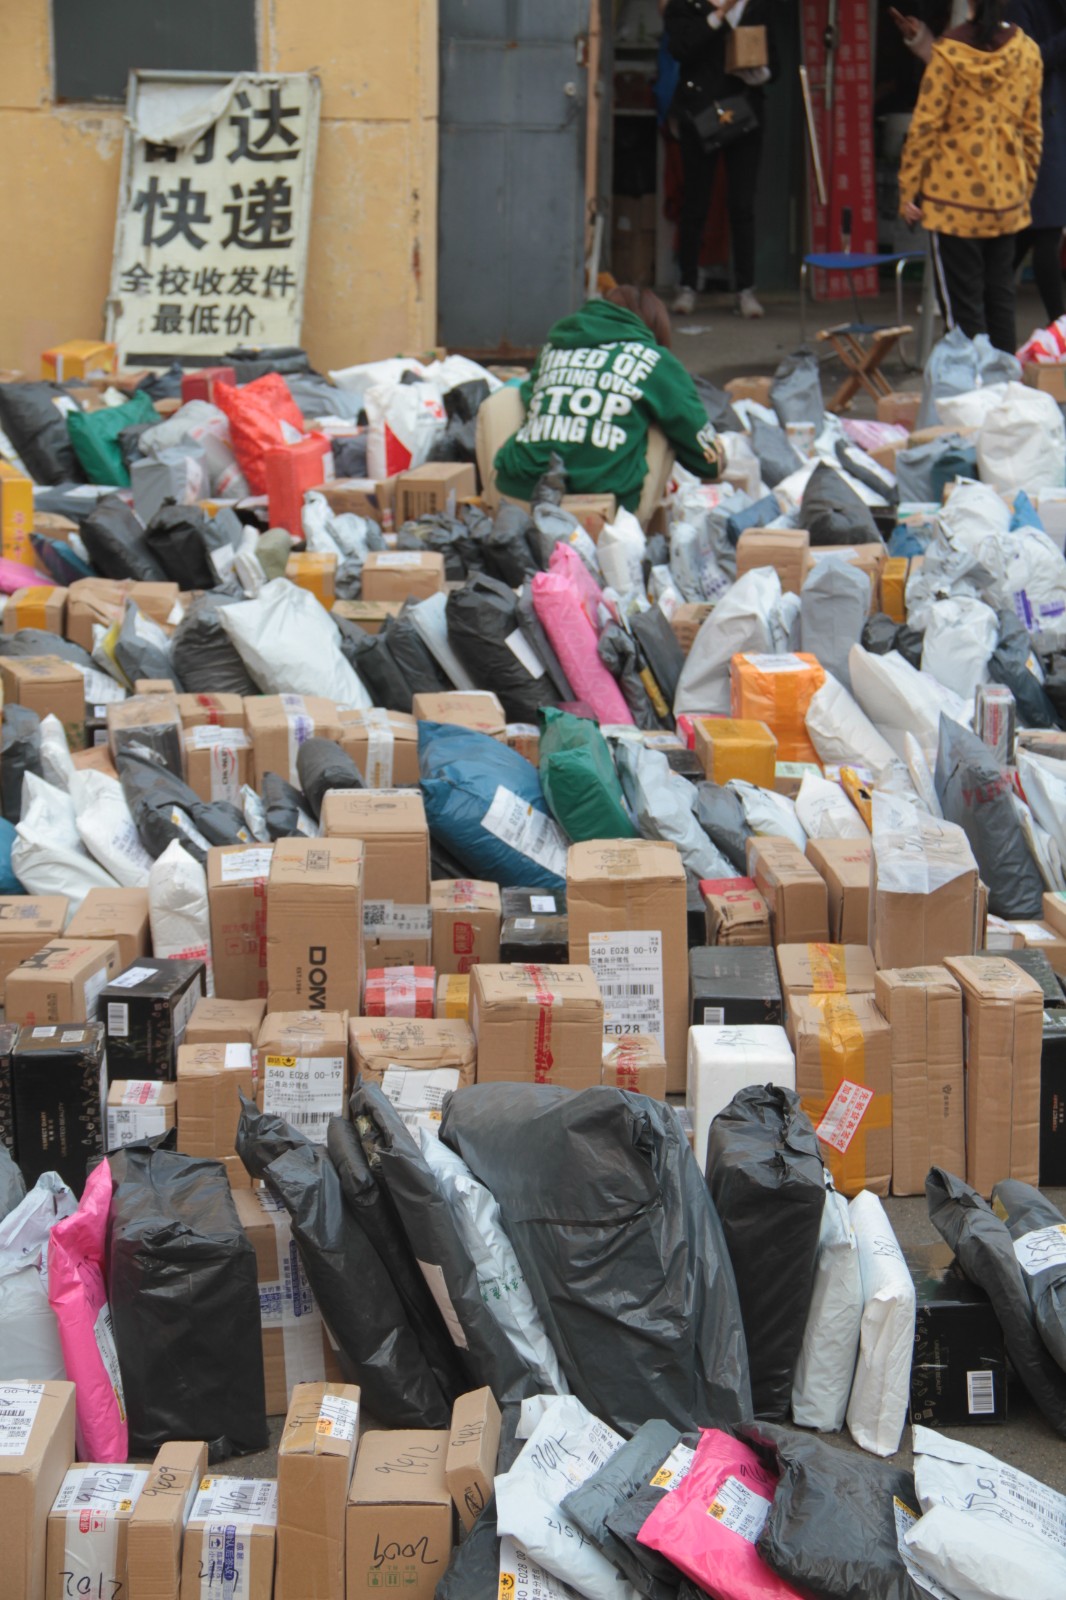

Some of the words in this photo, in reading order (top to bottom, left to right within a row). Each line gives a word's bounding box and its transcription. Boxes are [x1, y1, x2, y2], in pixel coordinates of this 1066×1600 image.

[133, 175, 293, 250] 快递
[121, 262, 297, 297] 全校收发件
[151, 303, 256, 336] 最低价
[611, 352, 653, 385] OF
[527, 385, 632, 422] STOP
[591, 419, 627, 452] UP
[591, 947, 606, 956] 540
[610, 946, 630, 955] E028
[633, 945, 658, 954] 00-19
[268, 1069, 285, 1079] 540
[289, 1071, 310, 1080] E028
[314, 1071, 341, 1080] 00-19
